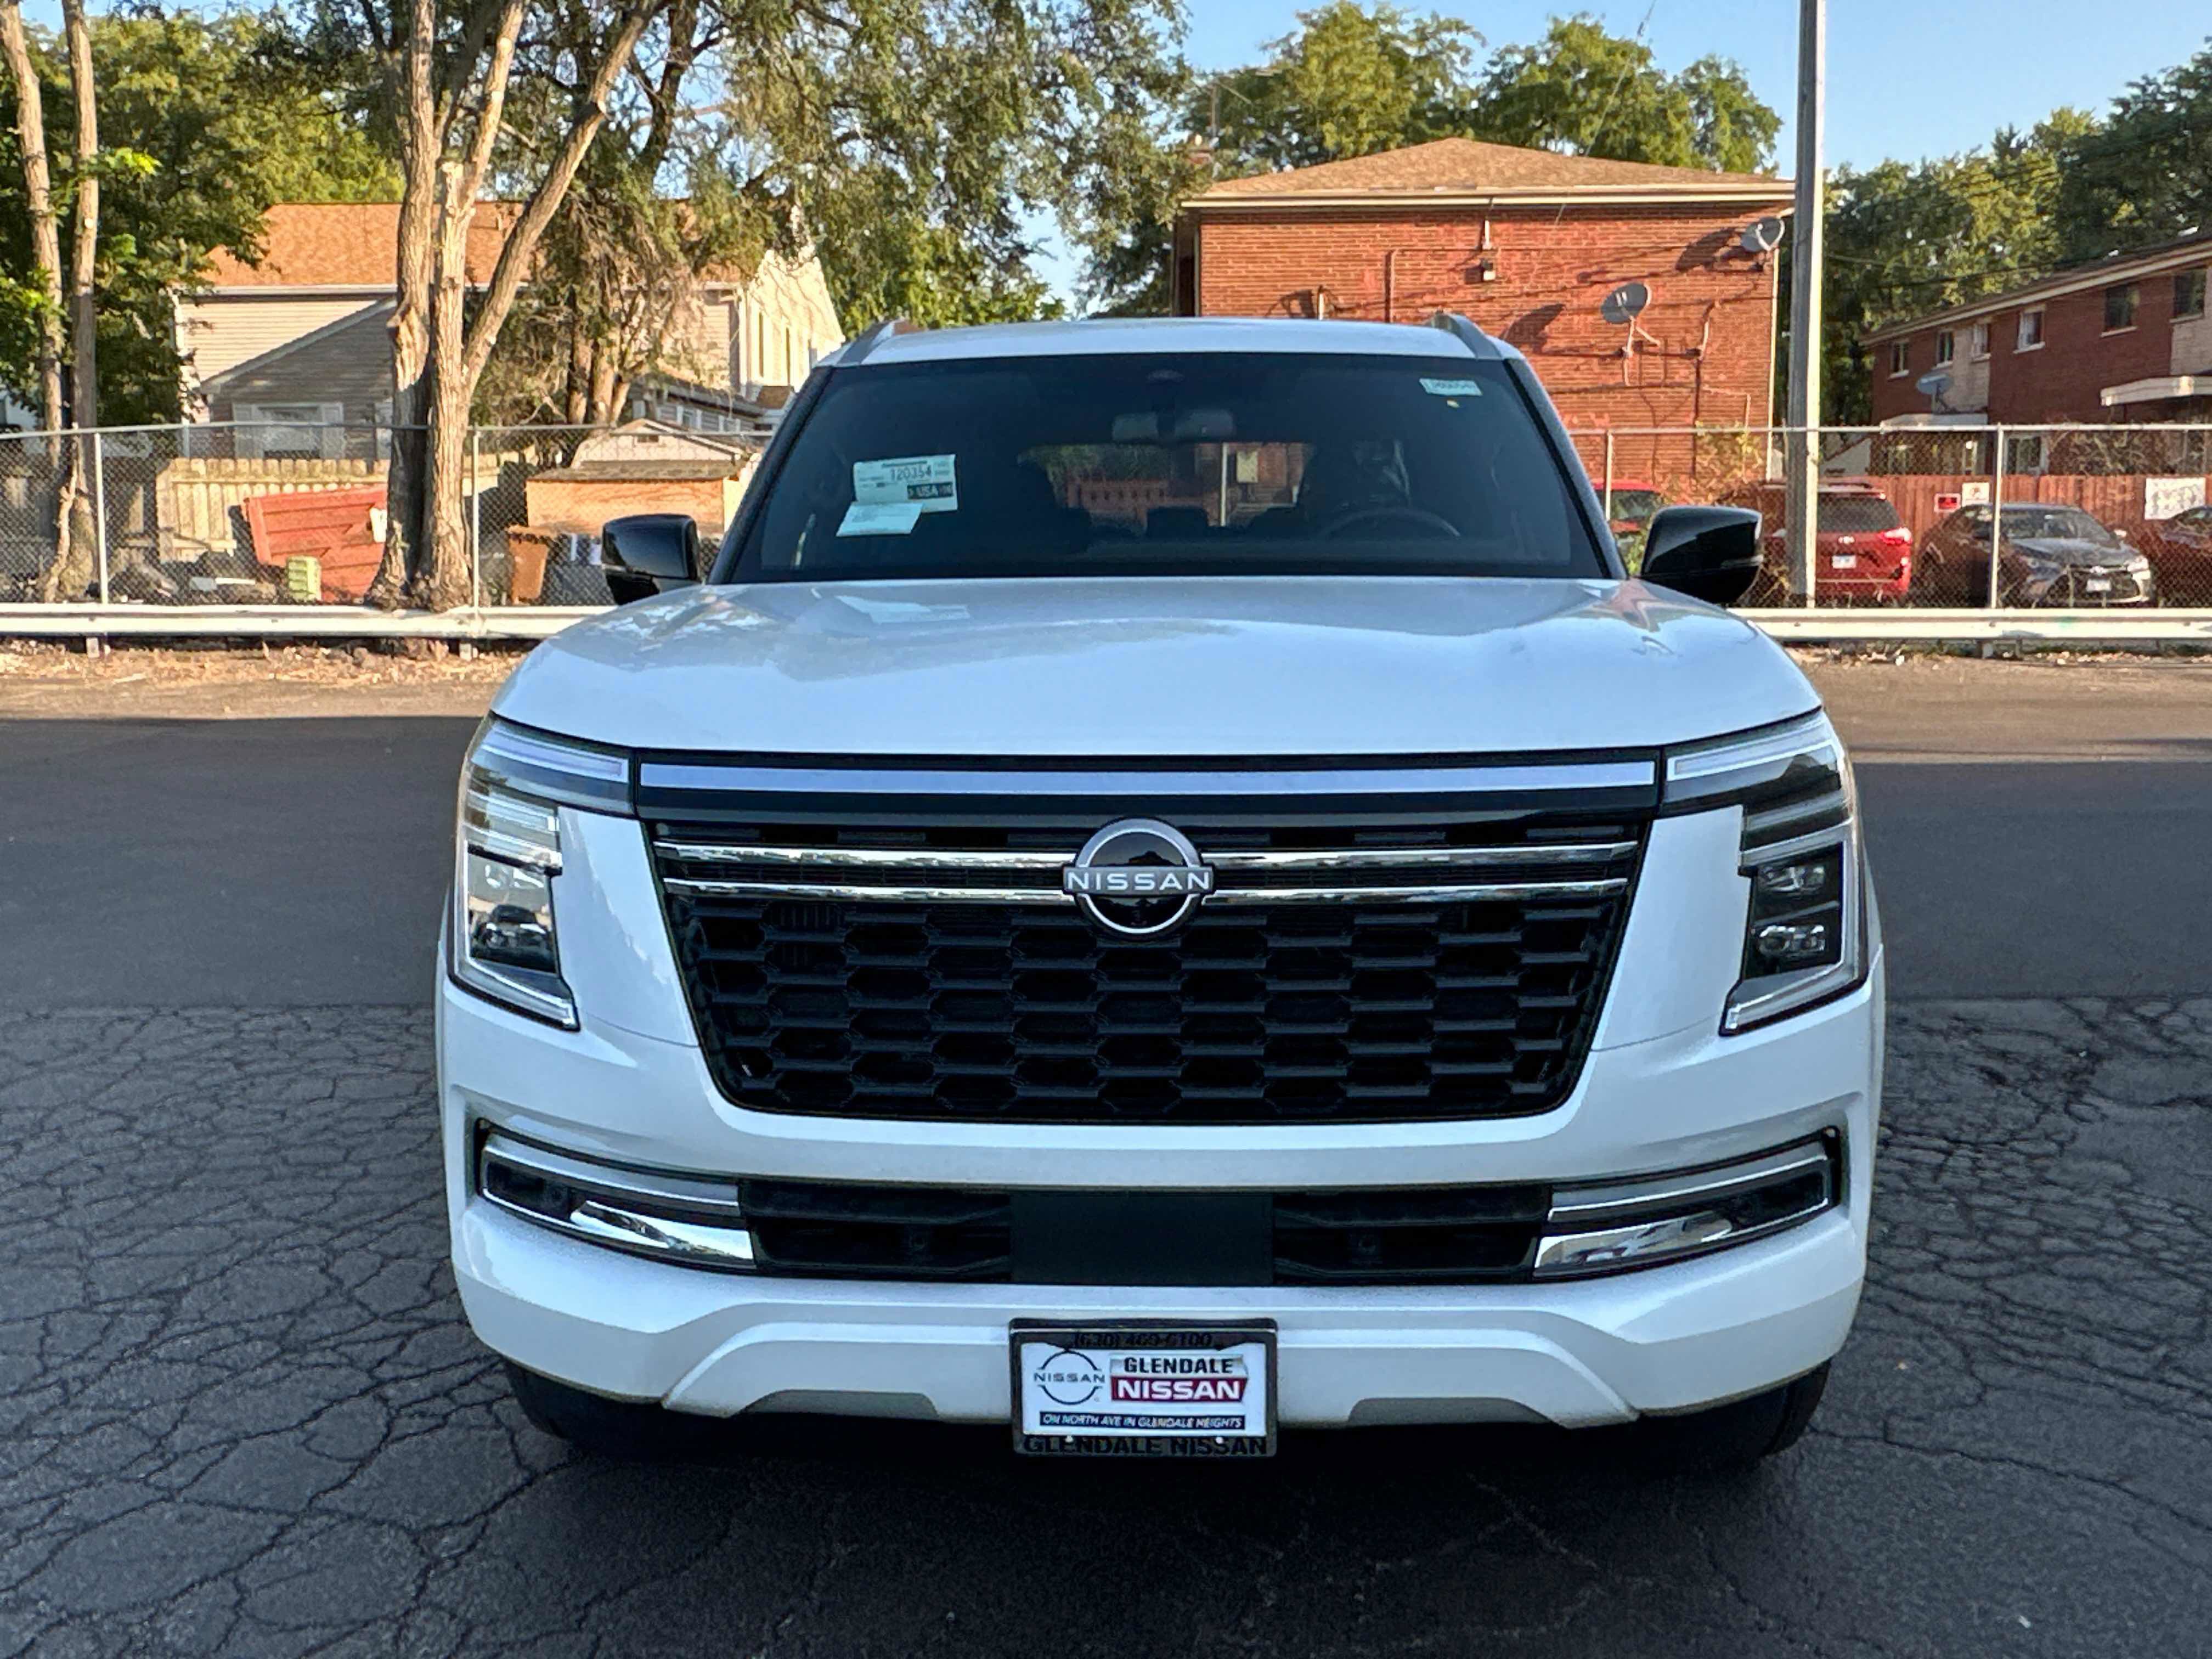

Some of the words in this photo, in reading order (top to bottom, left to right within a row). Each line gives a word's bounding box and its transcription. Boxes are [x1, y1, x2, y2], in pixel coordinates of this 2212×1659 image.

[1067, 871, 1210, 891] NISSAN
[1124, 1357, 1234, 1373] GLENDALE
[1034, 1373, 1105, 1383] NISSAN
[1118, 1379, 1240, 1400] NISSAN
[1043, 1414, 1060, 1424] ON
[1062, 1415, 1099, 1425] NORTH
[1101, 1416, 1122, 1426] AVE
[1196, 1418, 1242, 1427] HEIGHTS
[1024, 1435, 1161, 1453] GLENDALE
[1170, 1436, 1267, 1455] NISSAN
